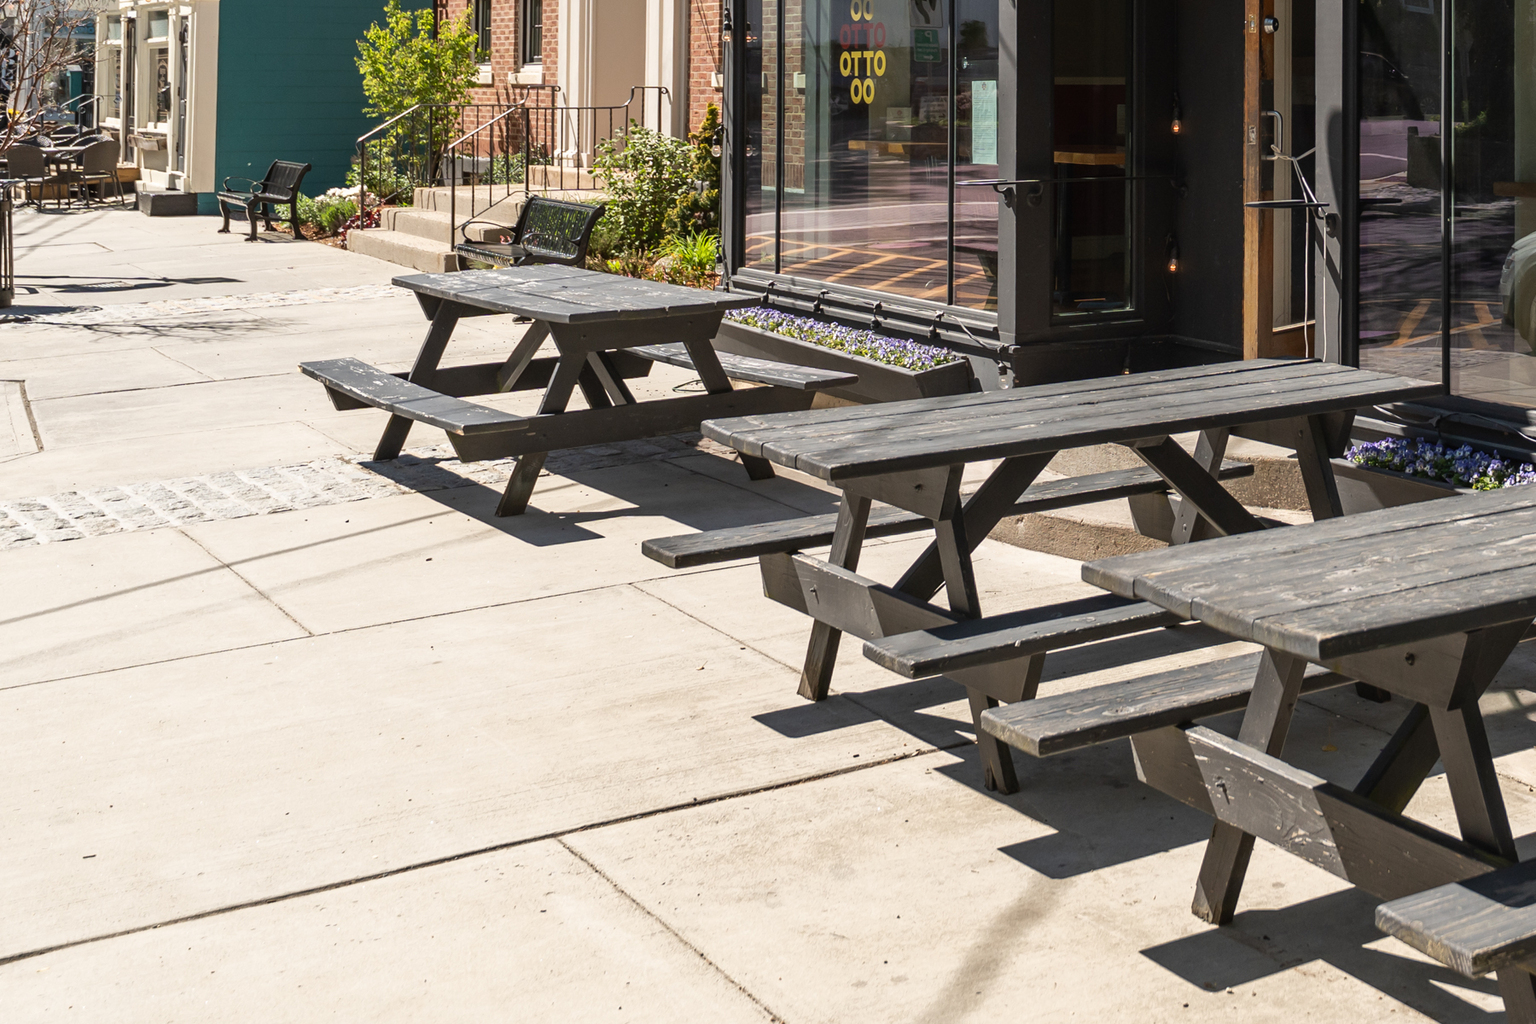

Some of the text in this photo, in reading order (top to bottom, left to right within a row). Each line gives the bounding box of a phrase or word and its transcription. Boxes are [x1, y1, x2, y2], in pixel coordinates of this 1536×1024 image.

[839, 21, 886, 50] OTTO
[839, 50, 886, 77] OTTO
[850, 77, 875, 104] OO
